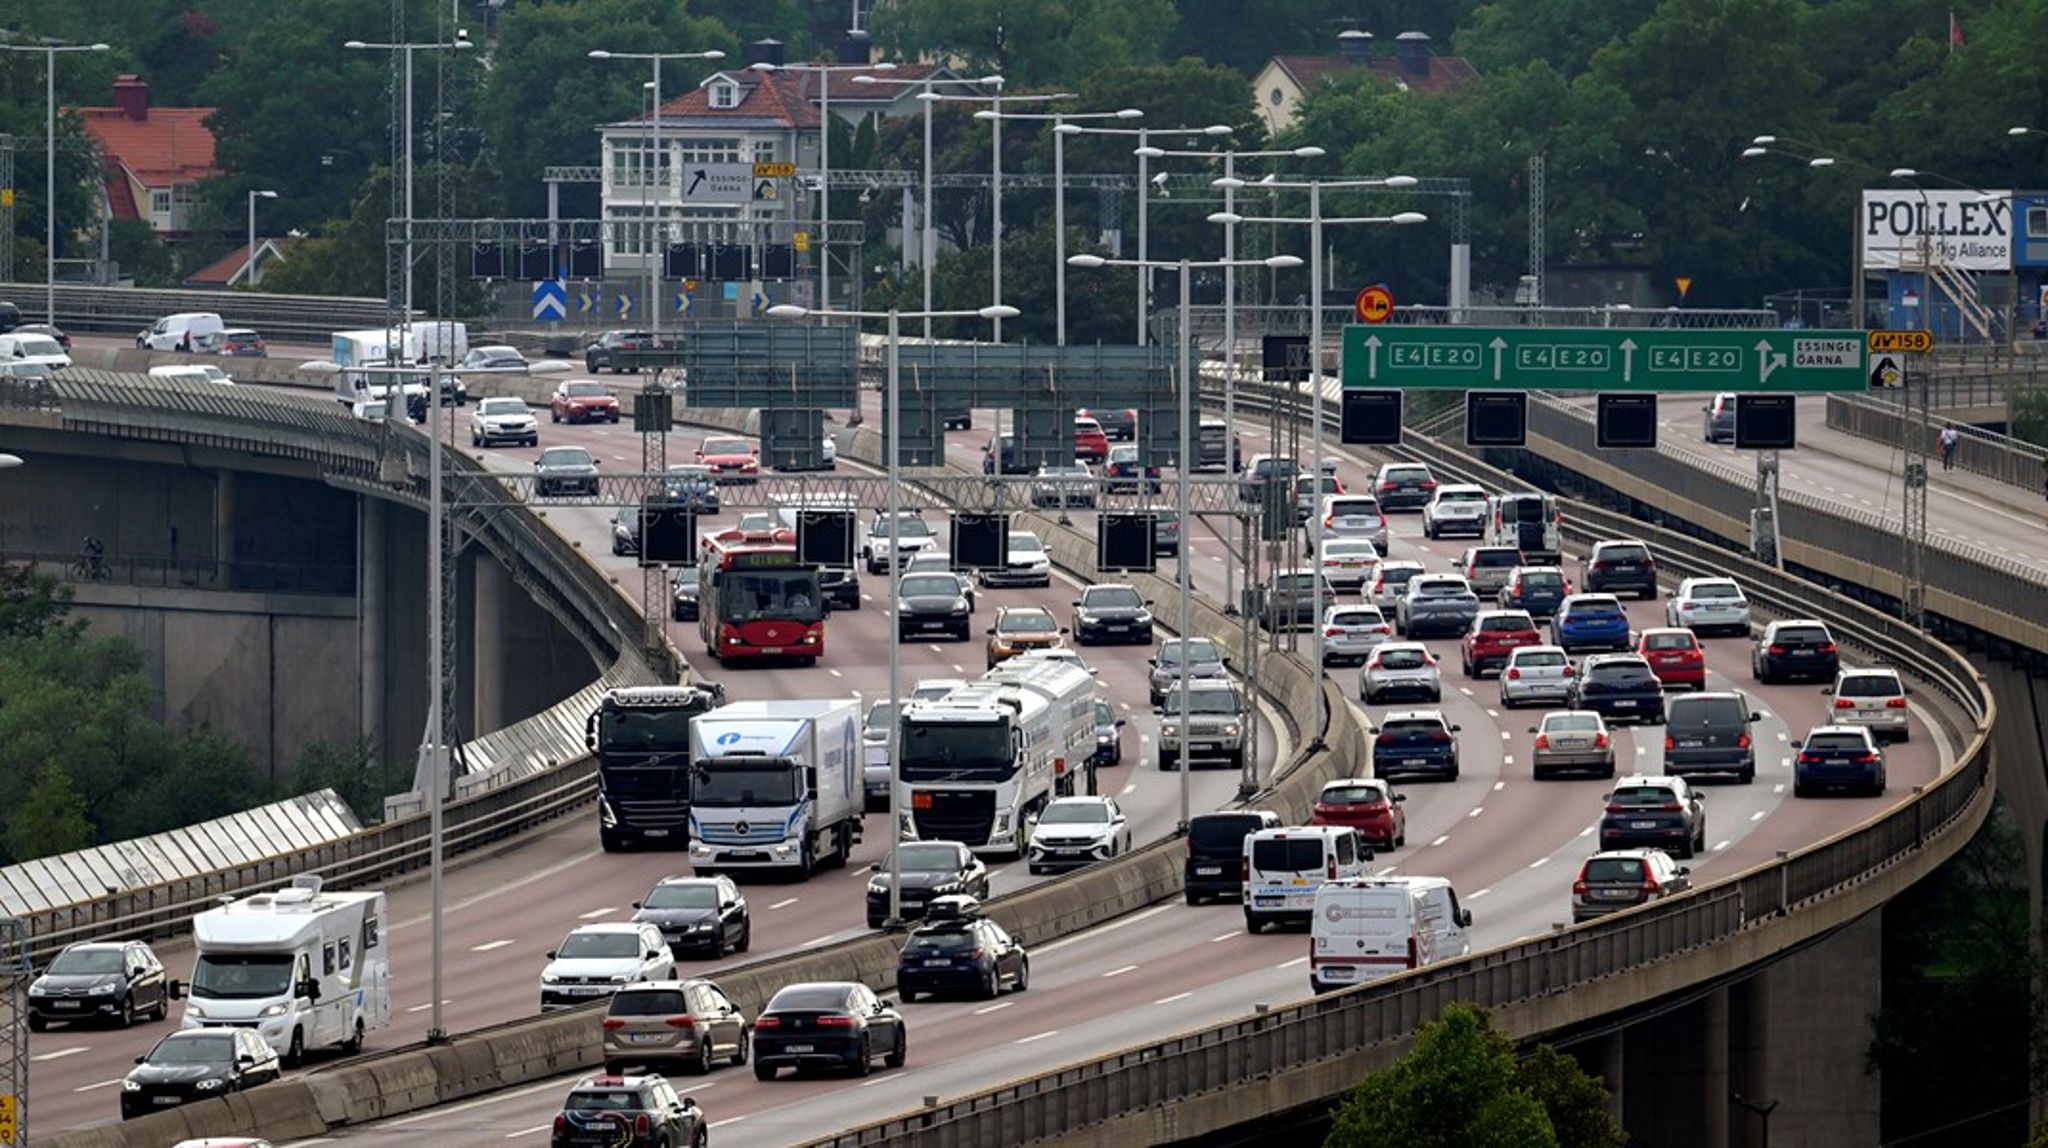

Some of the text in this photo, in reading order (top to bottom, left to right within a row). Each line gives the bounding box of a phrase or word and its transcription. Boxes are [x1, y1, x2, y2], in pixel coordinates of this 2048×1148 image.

[1868, 201, 2007, 236] POLLEX
[1959, 241, 2007, 257] Alliance
[1797, 342, 1857, 352] ESSINGE-
[1797, 354, 1843, 365] ÖARNA
